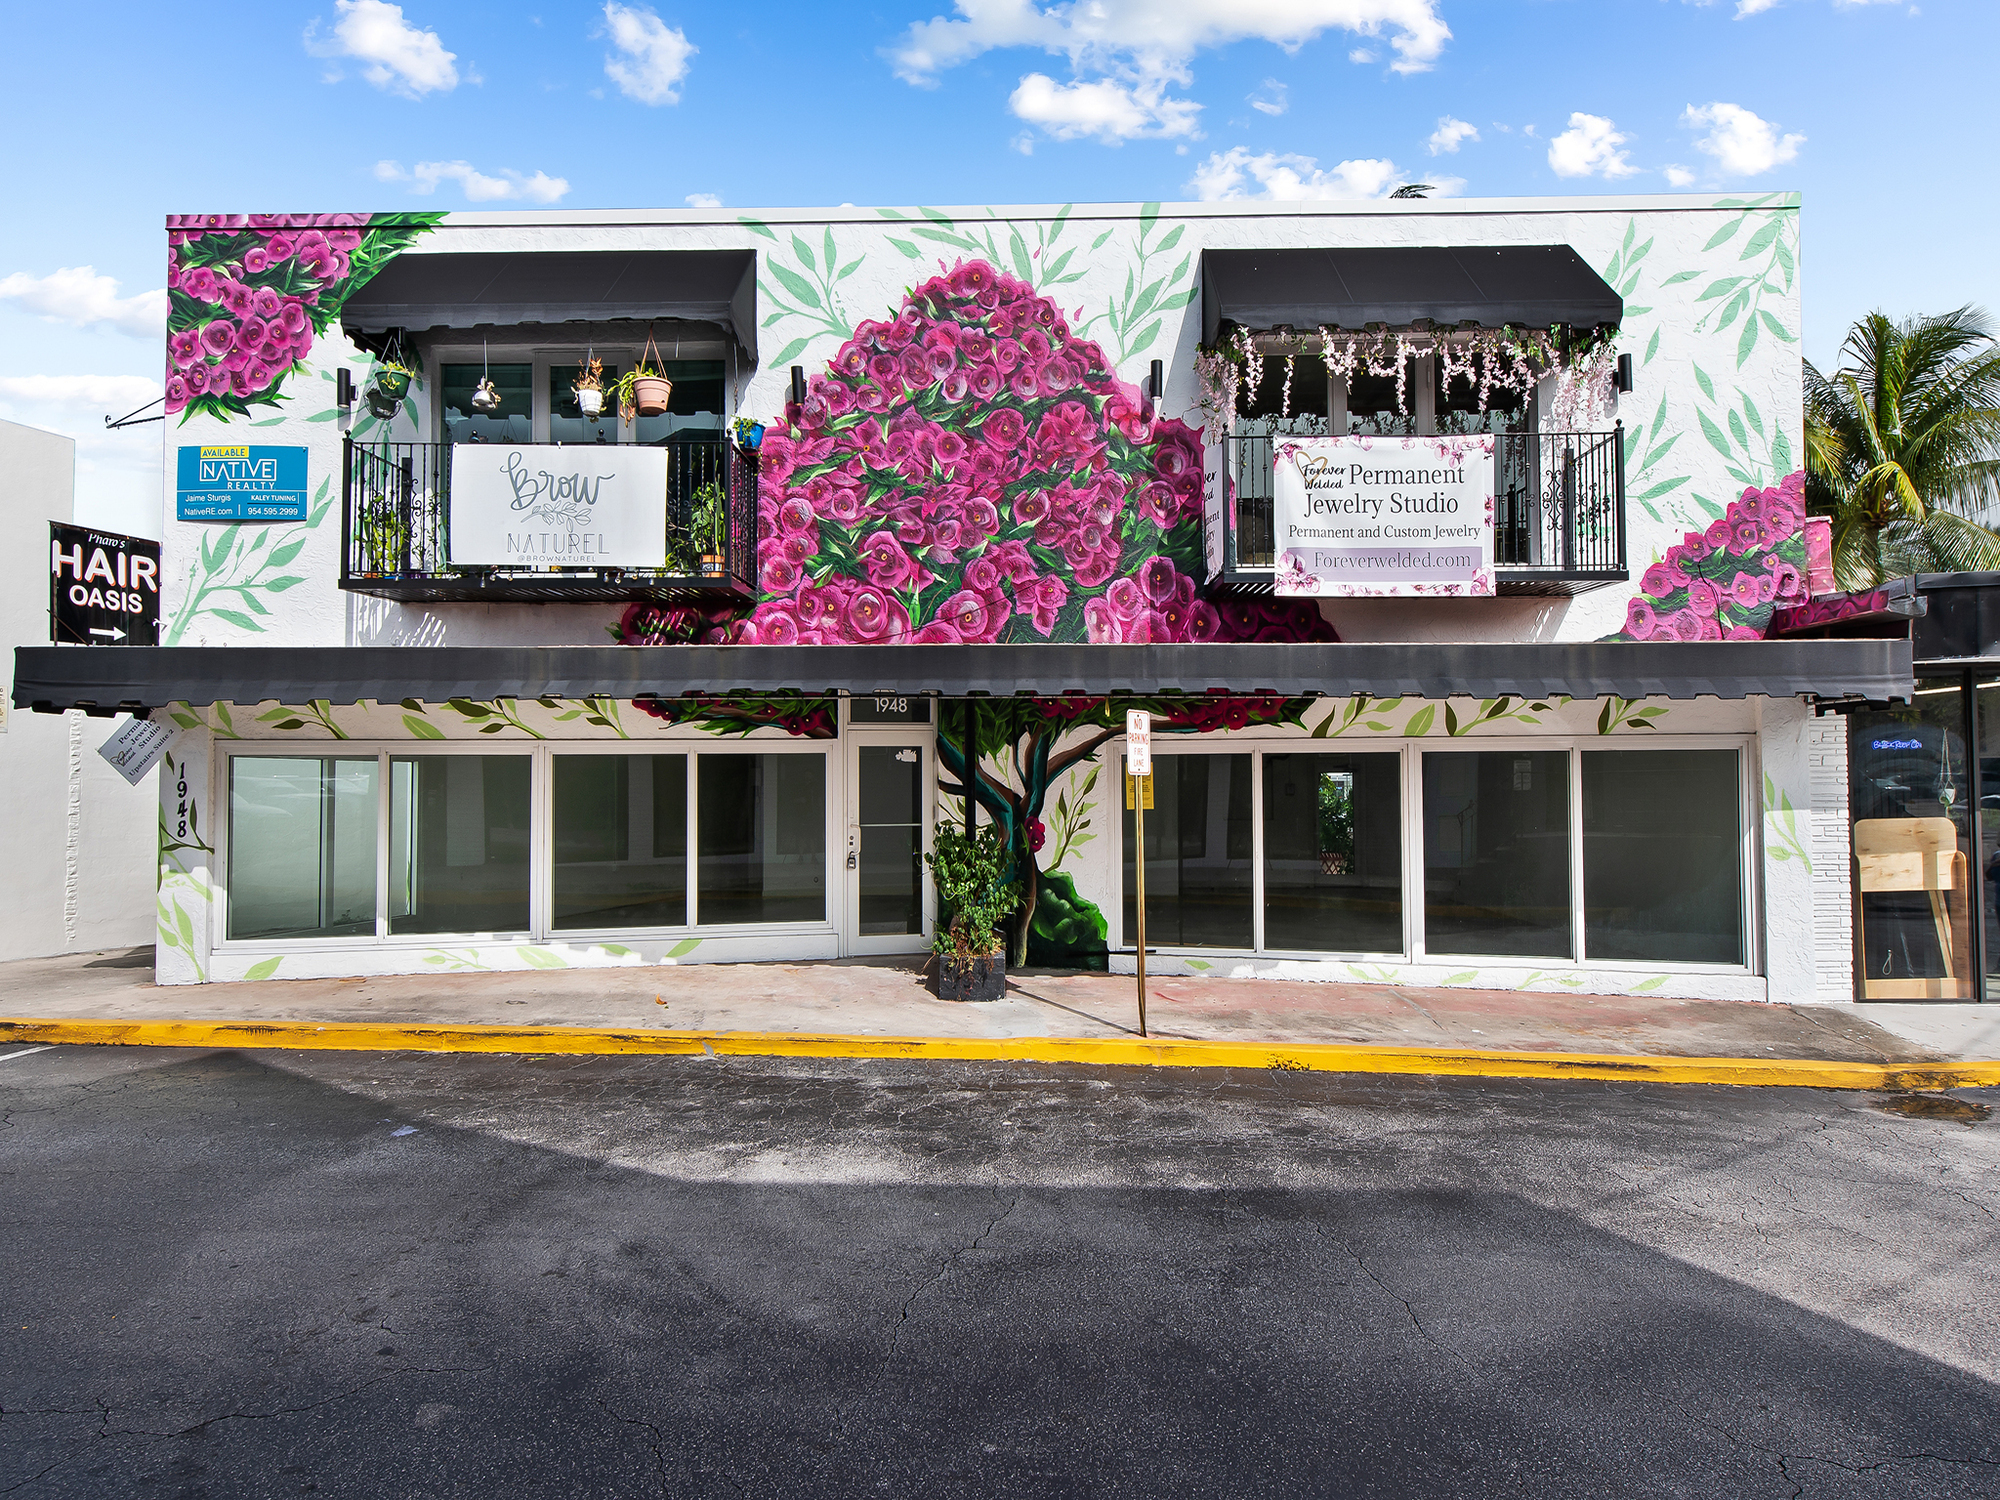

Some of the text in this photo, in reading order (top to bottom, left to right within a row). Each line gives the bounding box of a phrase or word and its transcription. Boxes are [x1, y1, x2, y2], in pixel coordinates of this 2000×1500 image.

[202, 448, 245, 457] AVAILABLE
[203, 461, 272, 478] NATIVE
[1302, 463, 1346, 477] Forever
[1349, 463, 1465, 485] Permanent
[227, 481, 275, 490] REALTY
[499, 451, 616, 511] Brow
[1304, 479, 1344, 490] Welded
[185, 493, 231, 503] Jaime Sturgis
[1304, 492, 1459, 519] Jewelry Studio
[184, 507, 233, 516] NativeRE.com
[247, 507, 298, 516] 954.595.2999
[1288, 524, 1481, 540] Permanent and Custom Jewelry
[88, 533, 126, 549] Pharo's
[507, 533, 610, 554] NATUREL
[52, 539, 158, 593] HAIR
[517, 554, 596, 563] @BROWNATUREL
[1315, 552, 1472, 568] Foreverwelded.com
[69, 585, 143, 614] OASIS
[874, 697, 908, 713] 1948
[130, 717, 157, 746] Jewelry
[1133, 718, 1143, 730] NO
[138, 725, 161, 749] Studio
[1128, 732, 1149, 745] PARKING
[128, 748, 155, 776] Upstairs
[153, 733, 171, 751] Suite
[1133, 747, 1144, 756] FIRE
[1133, 759, 1145, 767] LANE
[176, 762, 188, 838] 1948
